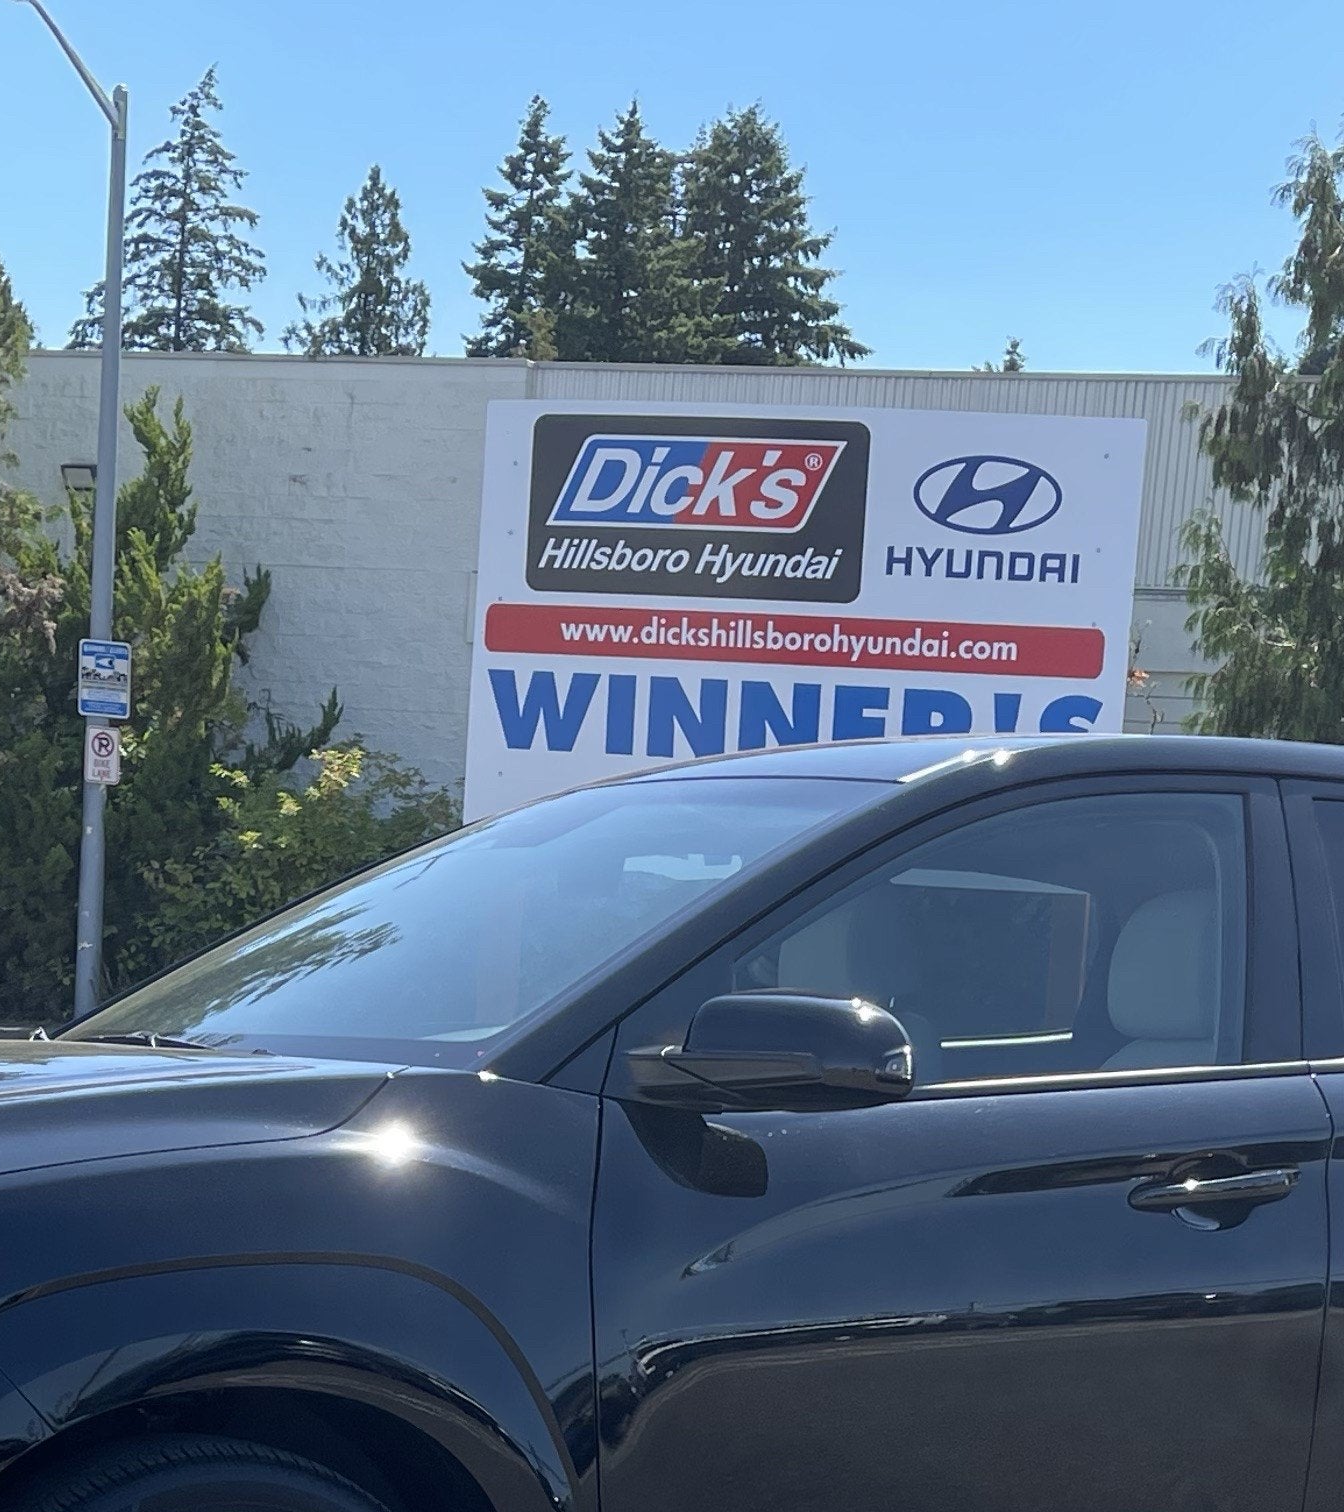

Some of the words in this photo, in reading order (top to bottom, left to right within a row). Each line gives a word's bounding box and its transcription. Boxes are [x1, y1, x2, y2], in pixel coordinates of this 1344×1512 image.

[538, 538, 690, 574] Hillsboro
[695, 544, 843, 583] Hyundai
[886, 545, 1080, 584] HYUNDAI
[560, 616, 1018, 662] www.dickshillsborohyundai.com
